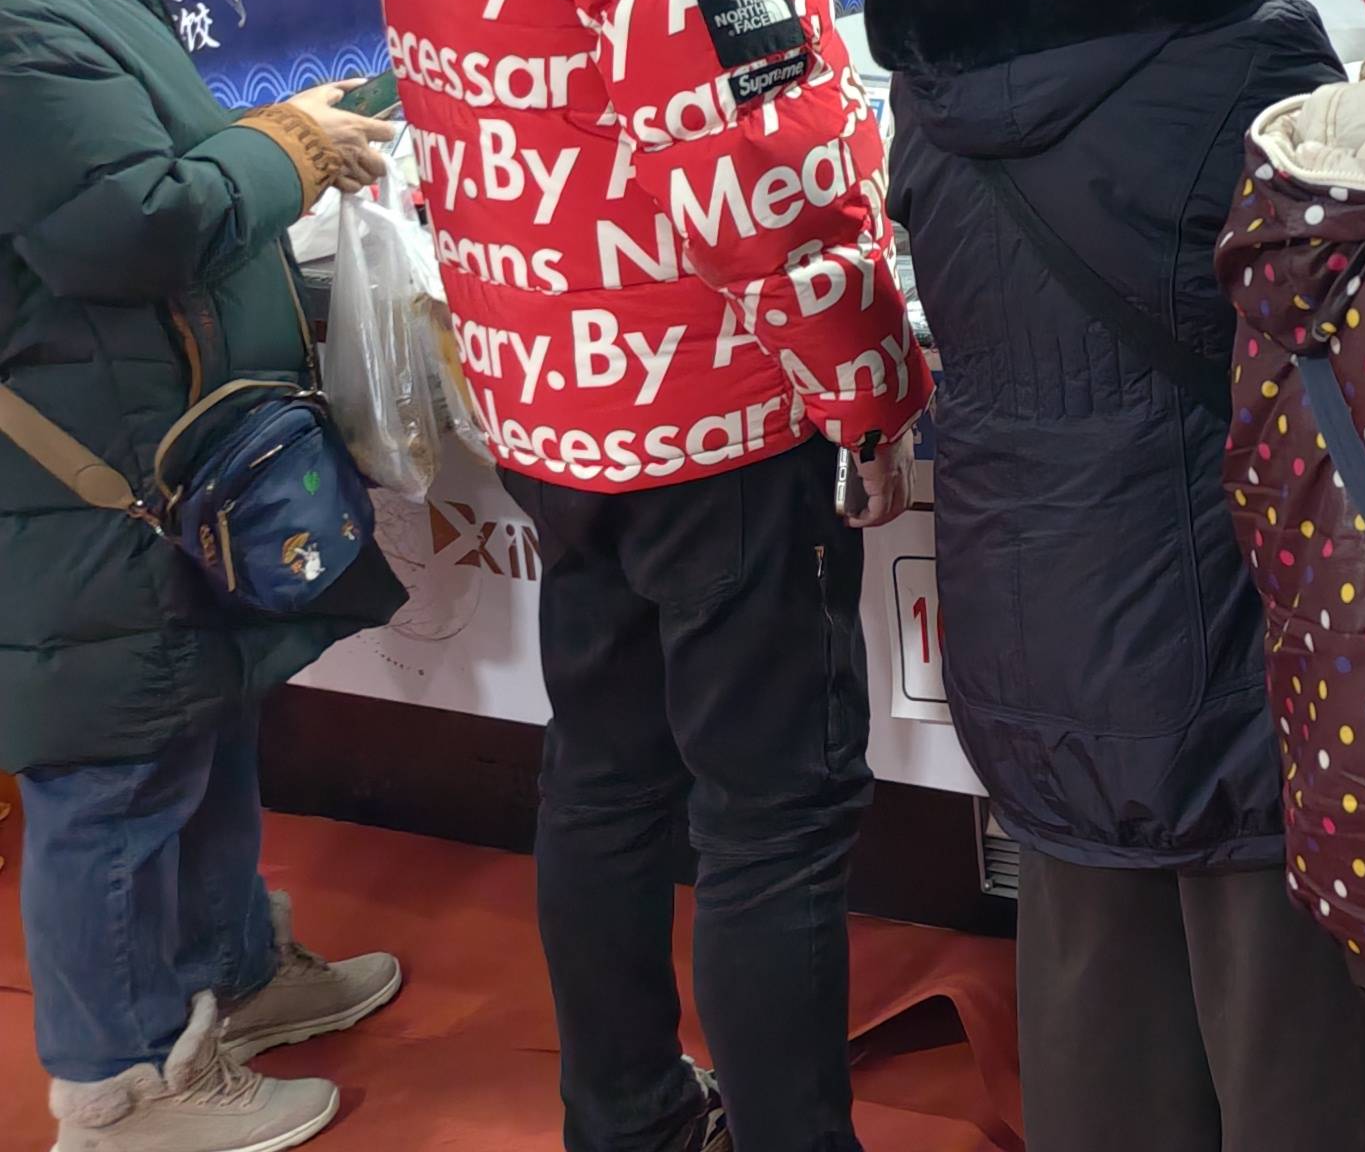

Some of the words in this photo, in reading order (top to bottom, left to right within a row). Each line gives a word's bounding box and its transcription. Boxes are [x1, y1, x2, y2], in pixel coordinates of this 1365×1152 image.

[713, 1, 766, 28] NORTH
[733, 13, 772, 35] FACE
[738, 60, 805, 97] Supreme
[912, 596, 945, 664] 1
